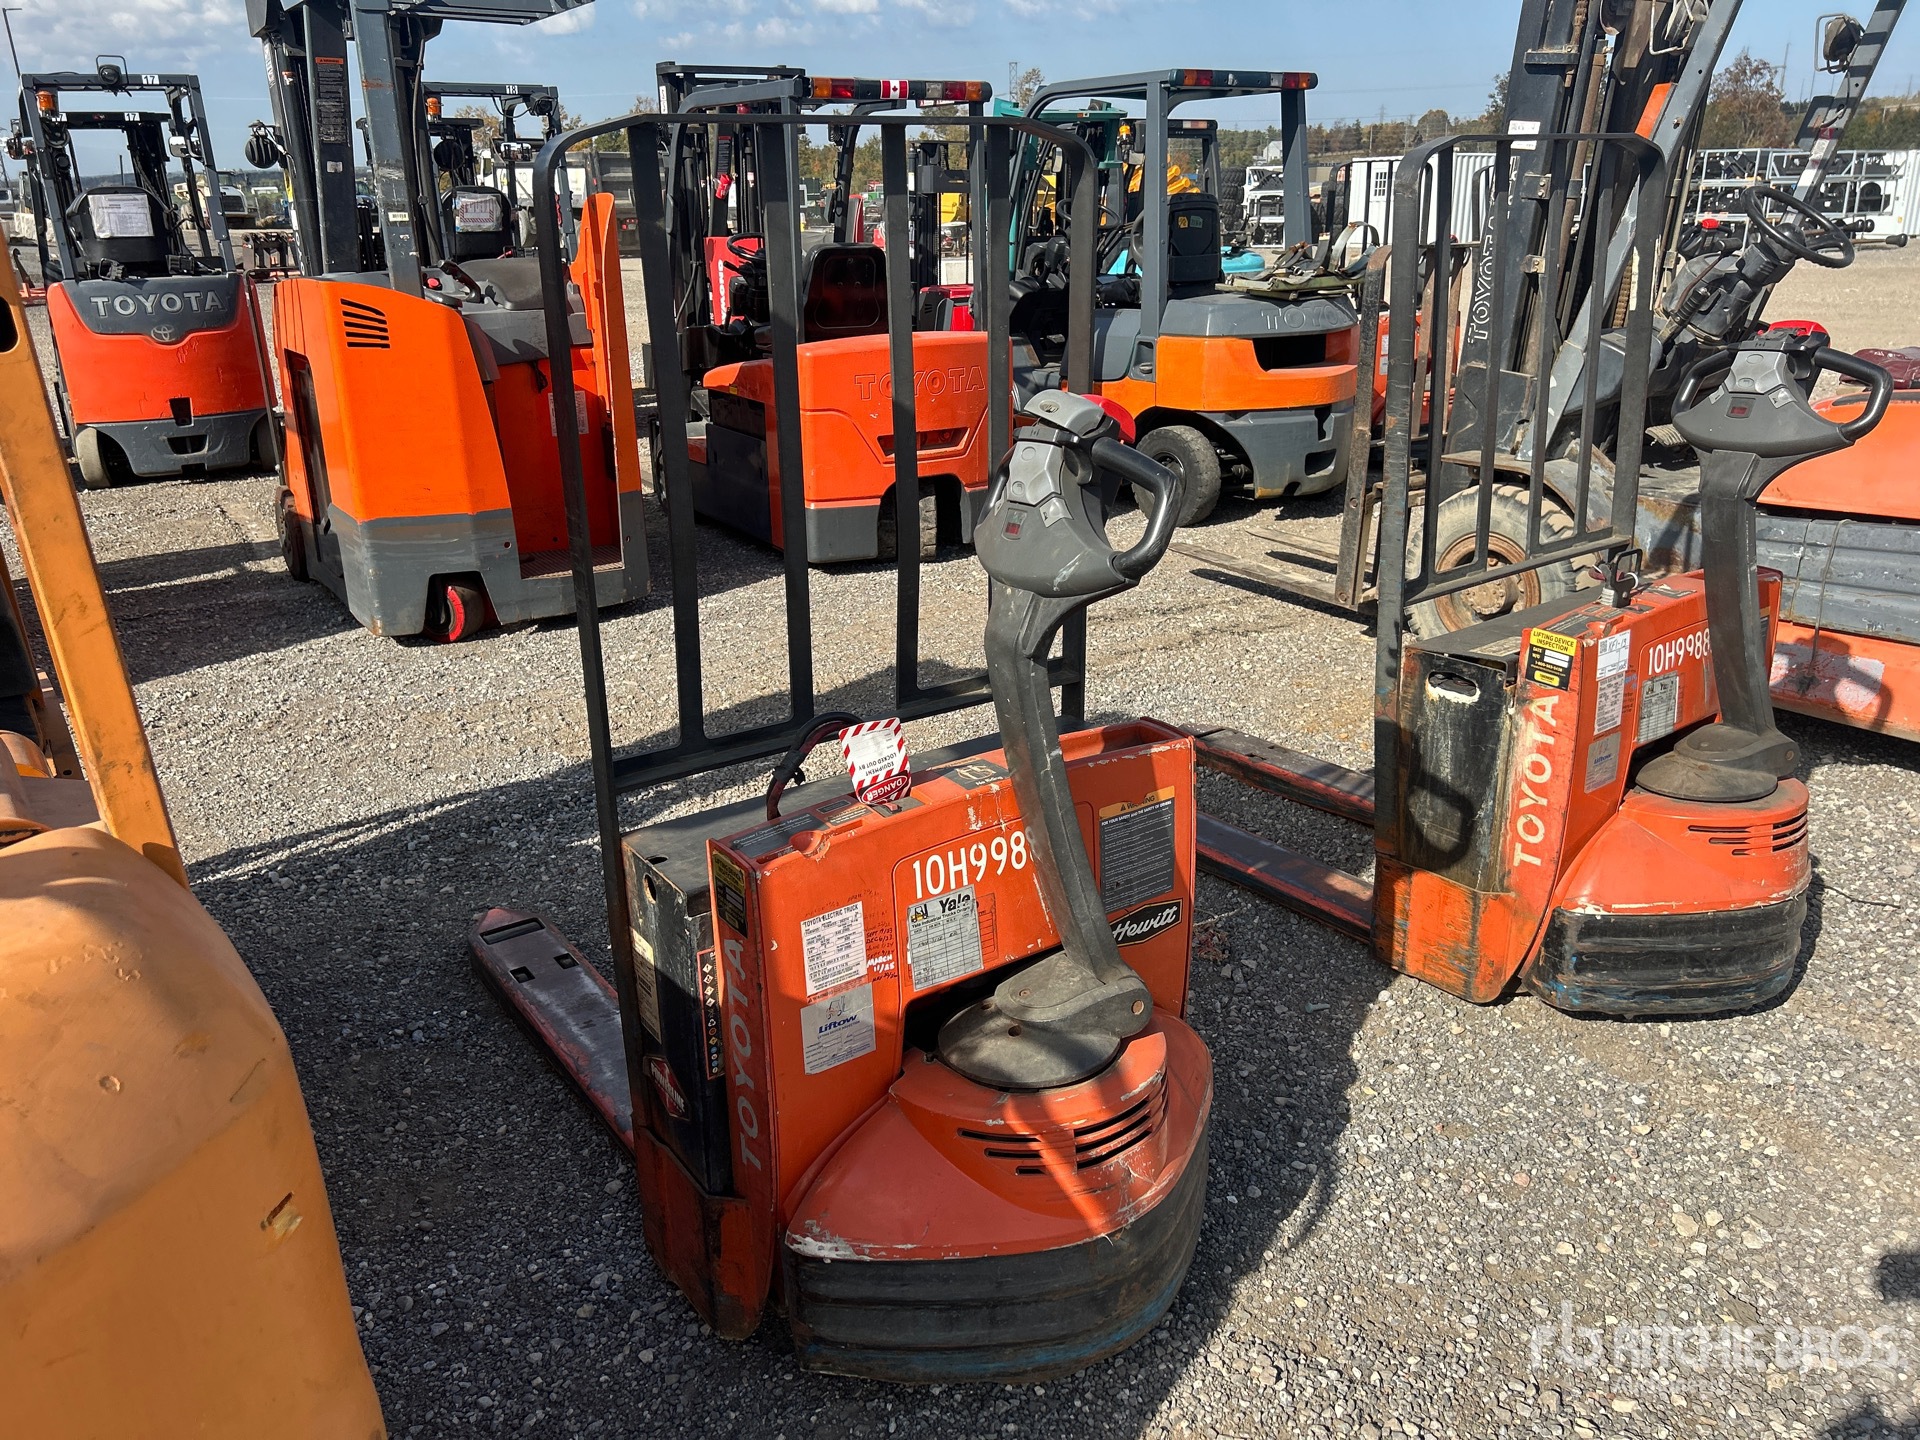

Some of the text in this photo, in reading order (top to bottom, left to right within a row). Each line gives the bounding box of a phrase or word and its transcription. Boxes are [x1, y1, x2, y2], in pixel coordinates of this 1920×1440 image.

[143, 75, 157, 85] 17
[506, 85, 518, 95] 18
[126, 113, 138, 122] 17
[90, 290, 226, 317] TOYOTA
[854, 365, 986, 400] TOYOTA
[1533, 630, 1574, 648] LIFTING DEVICE
[1536, 638, 1568, 652] INSPECTION
[858, 752, 897, 771] LOCKED OUT BY
[865, 761, 895, 777] EQUIPMENT
[866, 778, 903, 801] DANGER
[1513, 694, 1559, 868] TOYOTA
[912, 830, 1029, 899] 10H998
[822, 909, 843, 922] ELECTRIC
[843, 904, 859, 915] TRUCK
[939, 893, 971, 914] Yale
[1113, 904, 1178, 942] Hewitt
[866, 953, 893, 968] MARCH
[818, 1014, 858, 1034] Liftow
[723, 938, 764, 1172] TOYOTA
